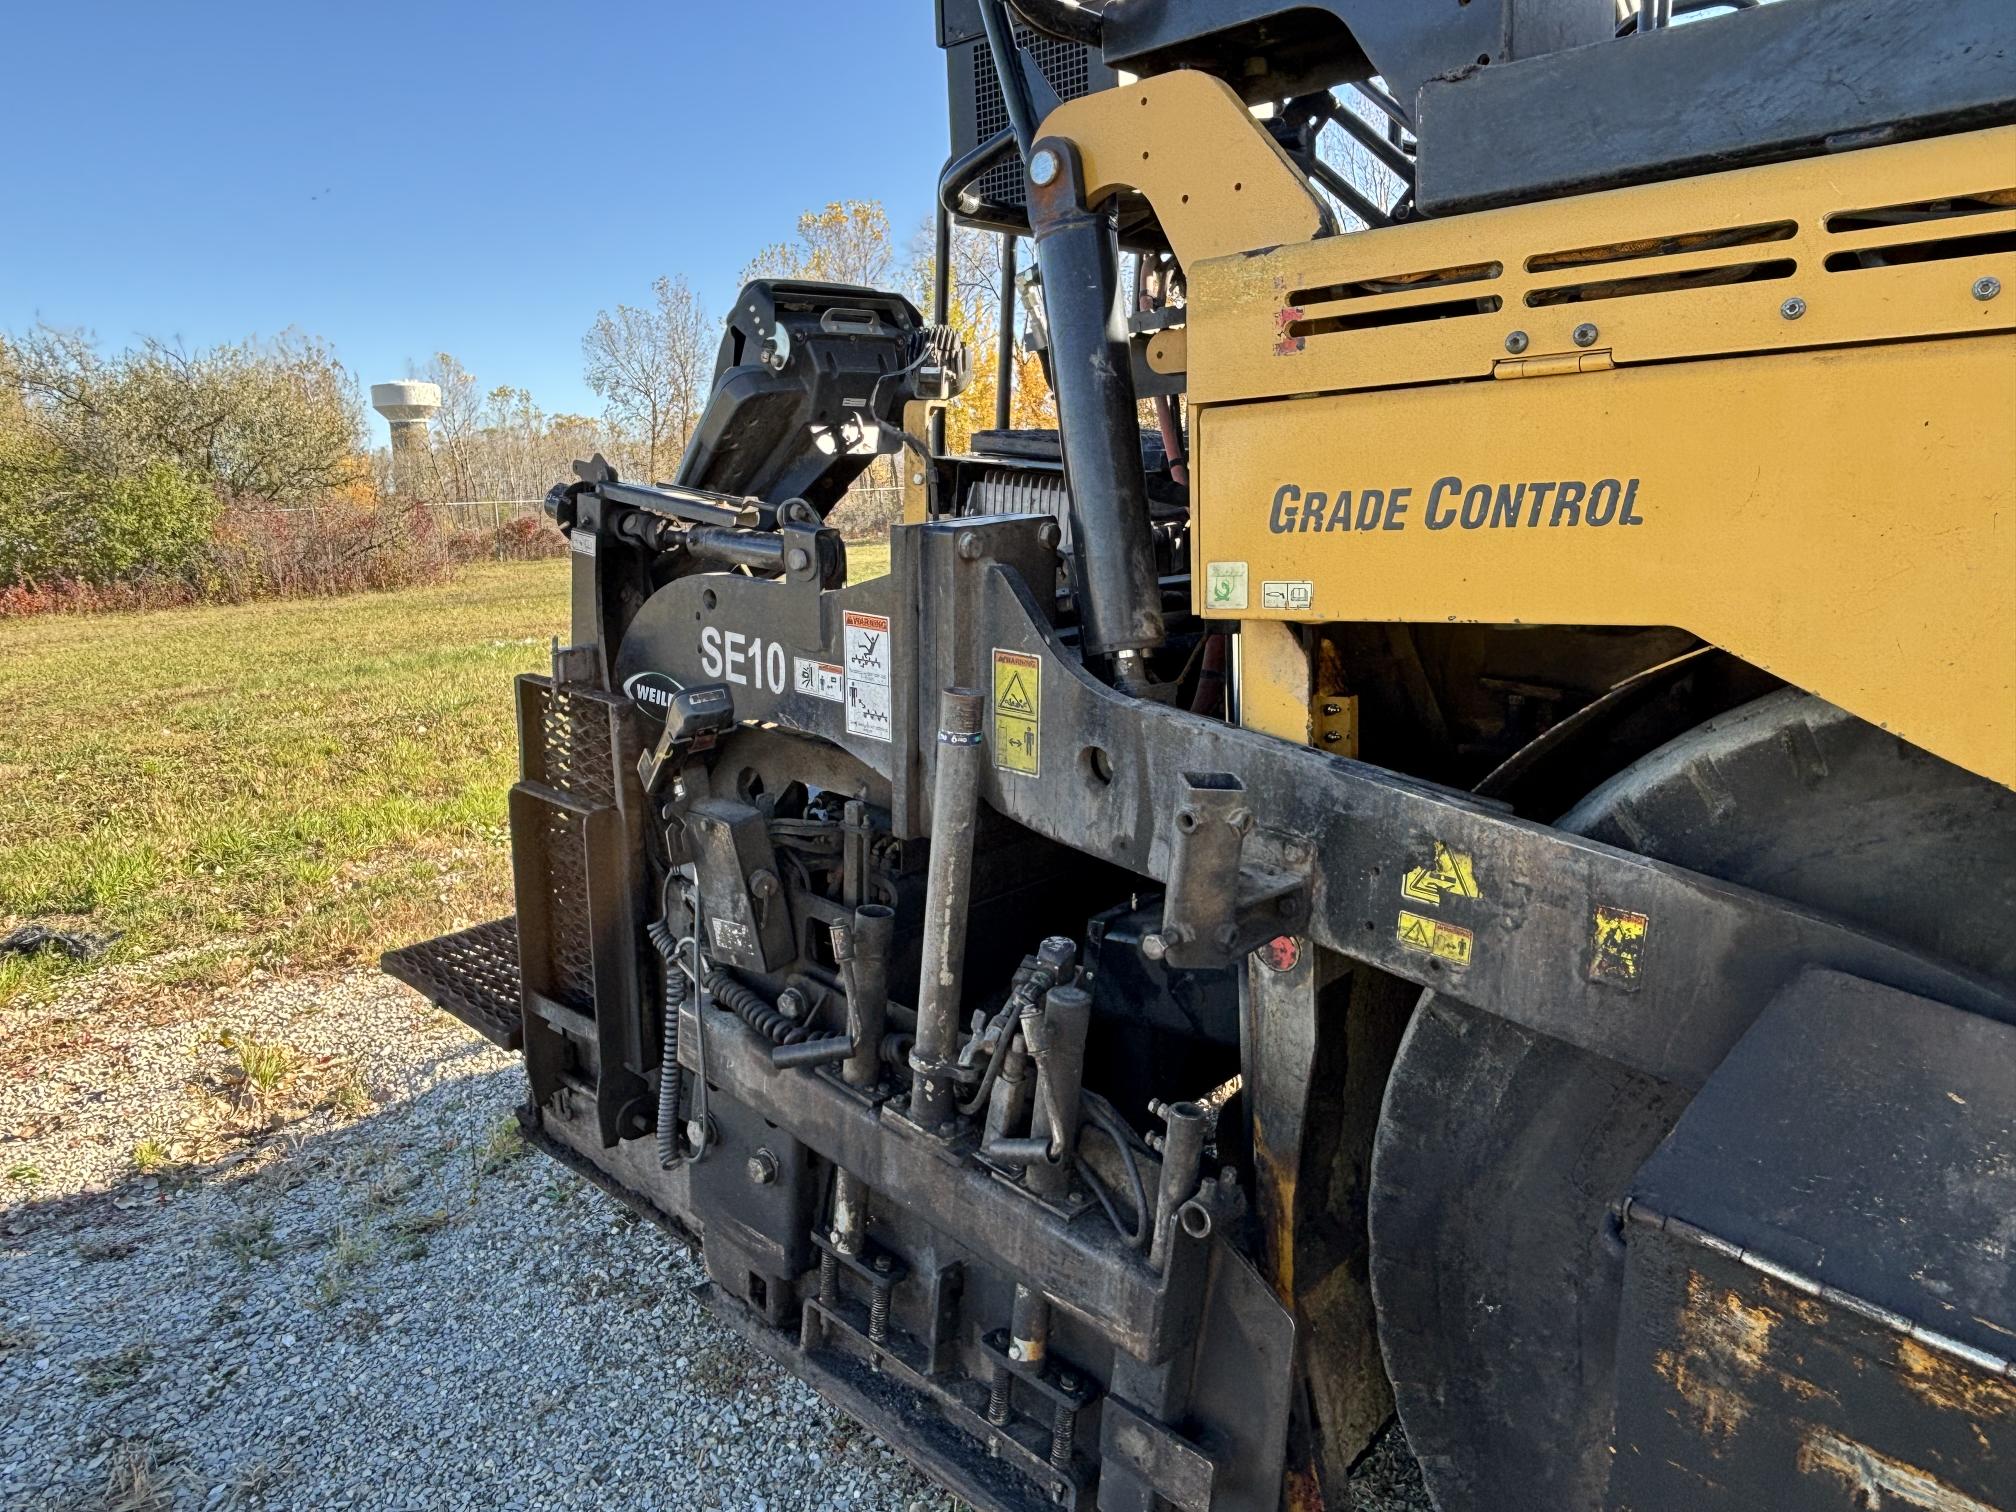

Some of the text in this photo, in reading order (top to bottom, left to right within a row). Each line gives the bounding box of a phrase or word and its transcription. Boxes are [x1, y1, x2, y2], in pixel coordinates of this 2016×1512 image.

[1269, 476, 1644, 534] GRADE CONTROL
[702, 626, 786, 694] SE10
